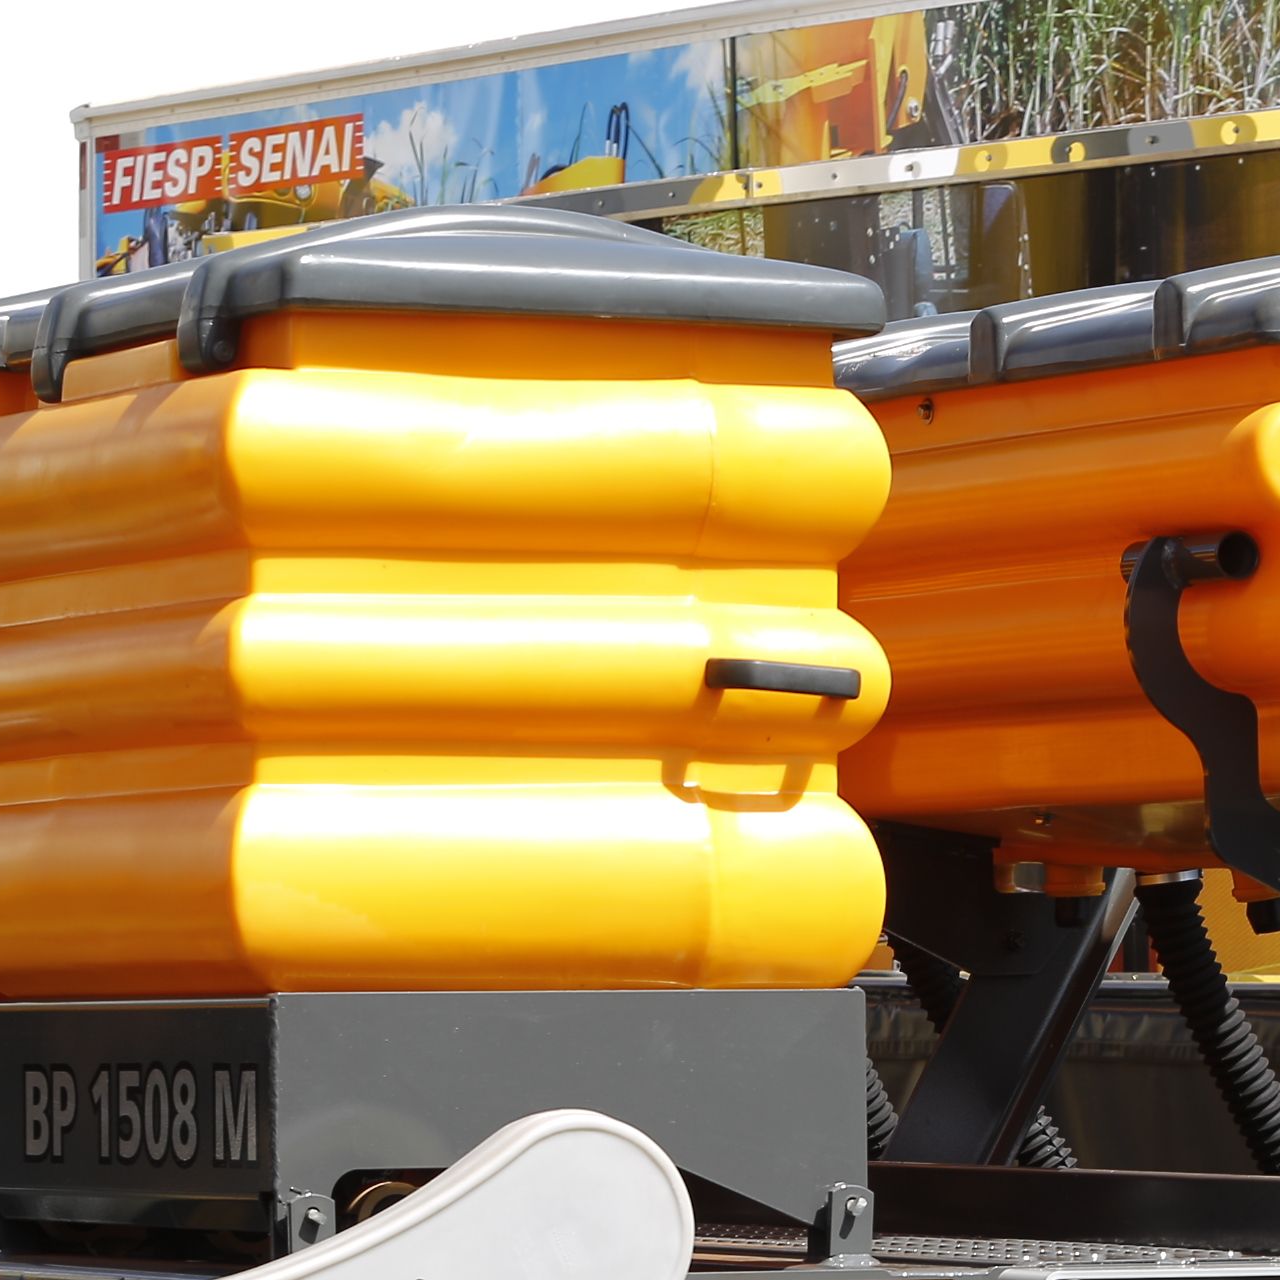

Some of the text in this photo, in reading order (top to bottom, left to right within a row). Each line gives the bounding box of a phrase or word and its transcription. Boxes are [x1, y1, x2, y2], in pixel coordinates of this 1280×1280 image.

[111, 123, 354, 205] FIESP SENAI
[24, 1067, 257, 1162] BP 1508 M
